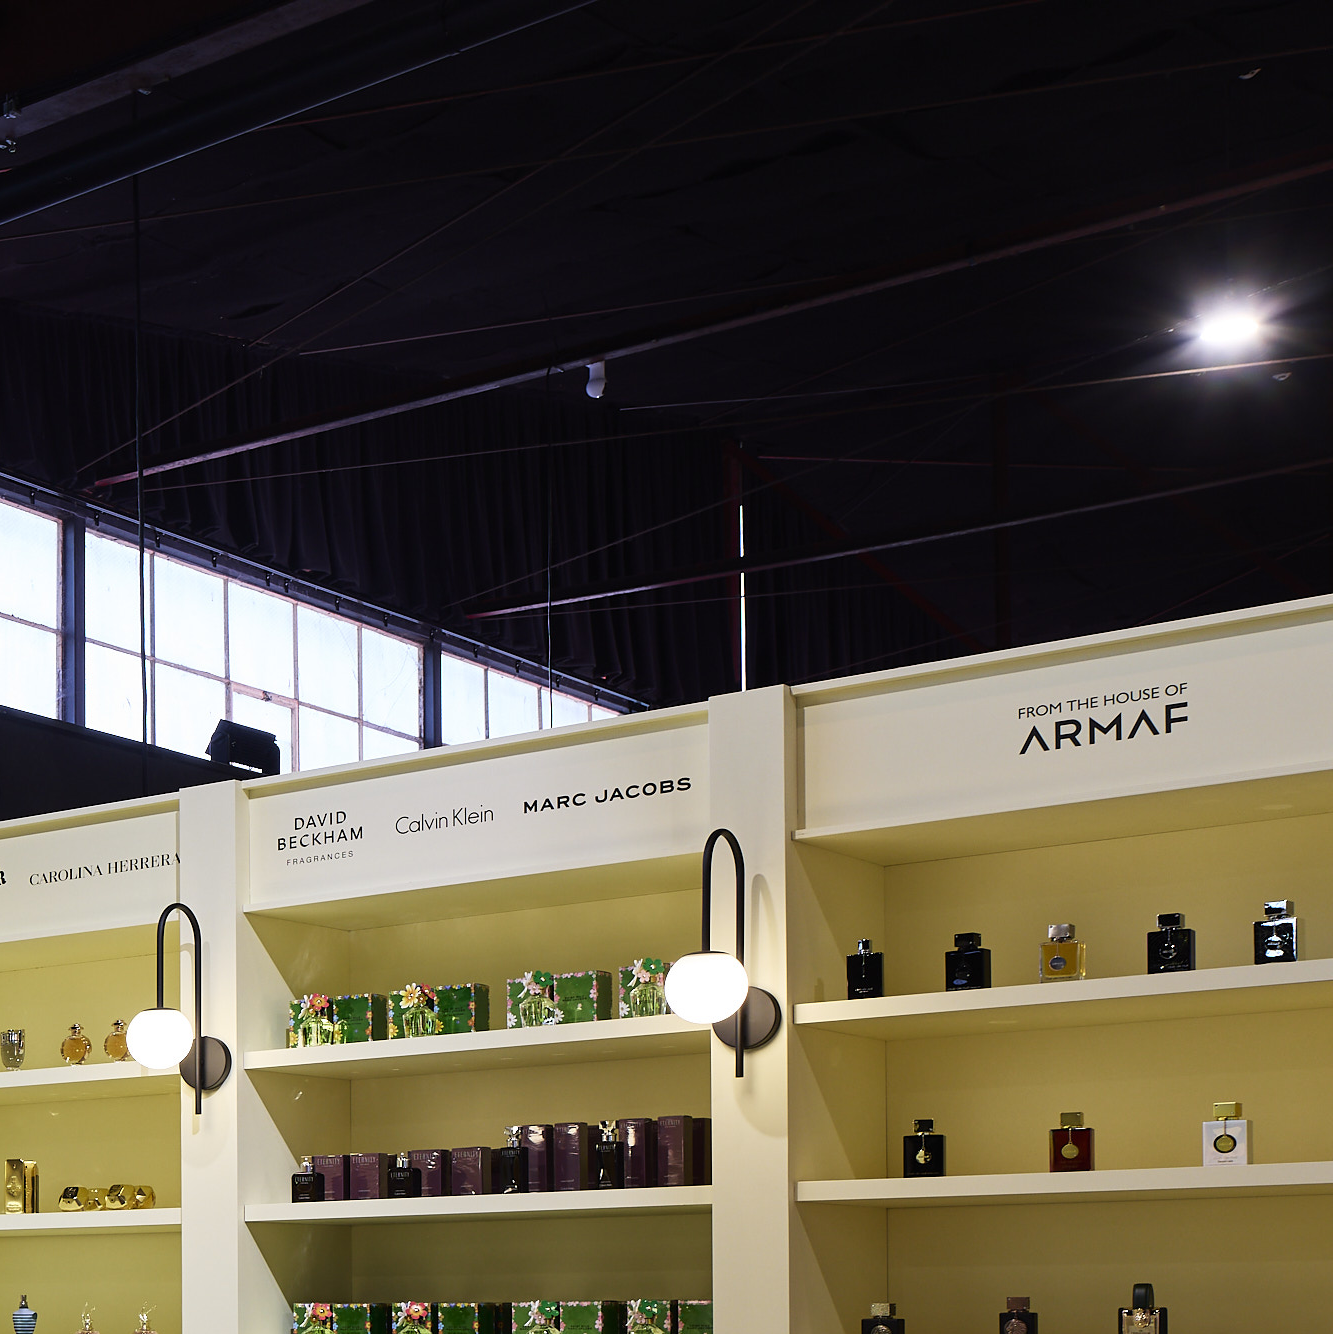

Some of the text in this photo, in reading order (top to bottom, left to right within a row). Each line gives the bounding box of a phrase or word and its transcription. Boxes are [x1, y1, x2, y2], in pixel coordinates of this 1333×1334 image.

[1018, 682, 1188, 720] FROM THE HOUSE OF
[1018, 701, 1189, 755] ARMAF
[523, 777, 692, 814] MARC JACOBS
[294, 810, 347, 831] DAVID
[395, 807, 494, 835] Calvin Klein
[277, 826, 363, 851] BECKHAM
[29, 852, 181, 886] CAROLINA HERRERA
[286, 850, 354, 866] FRAGRANCES
